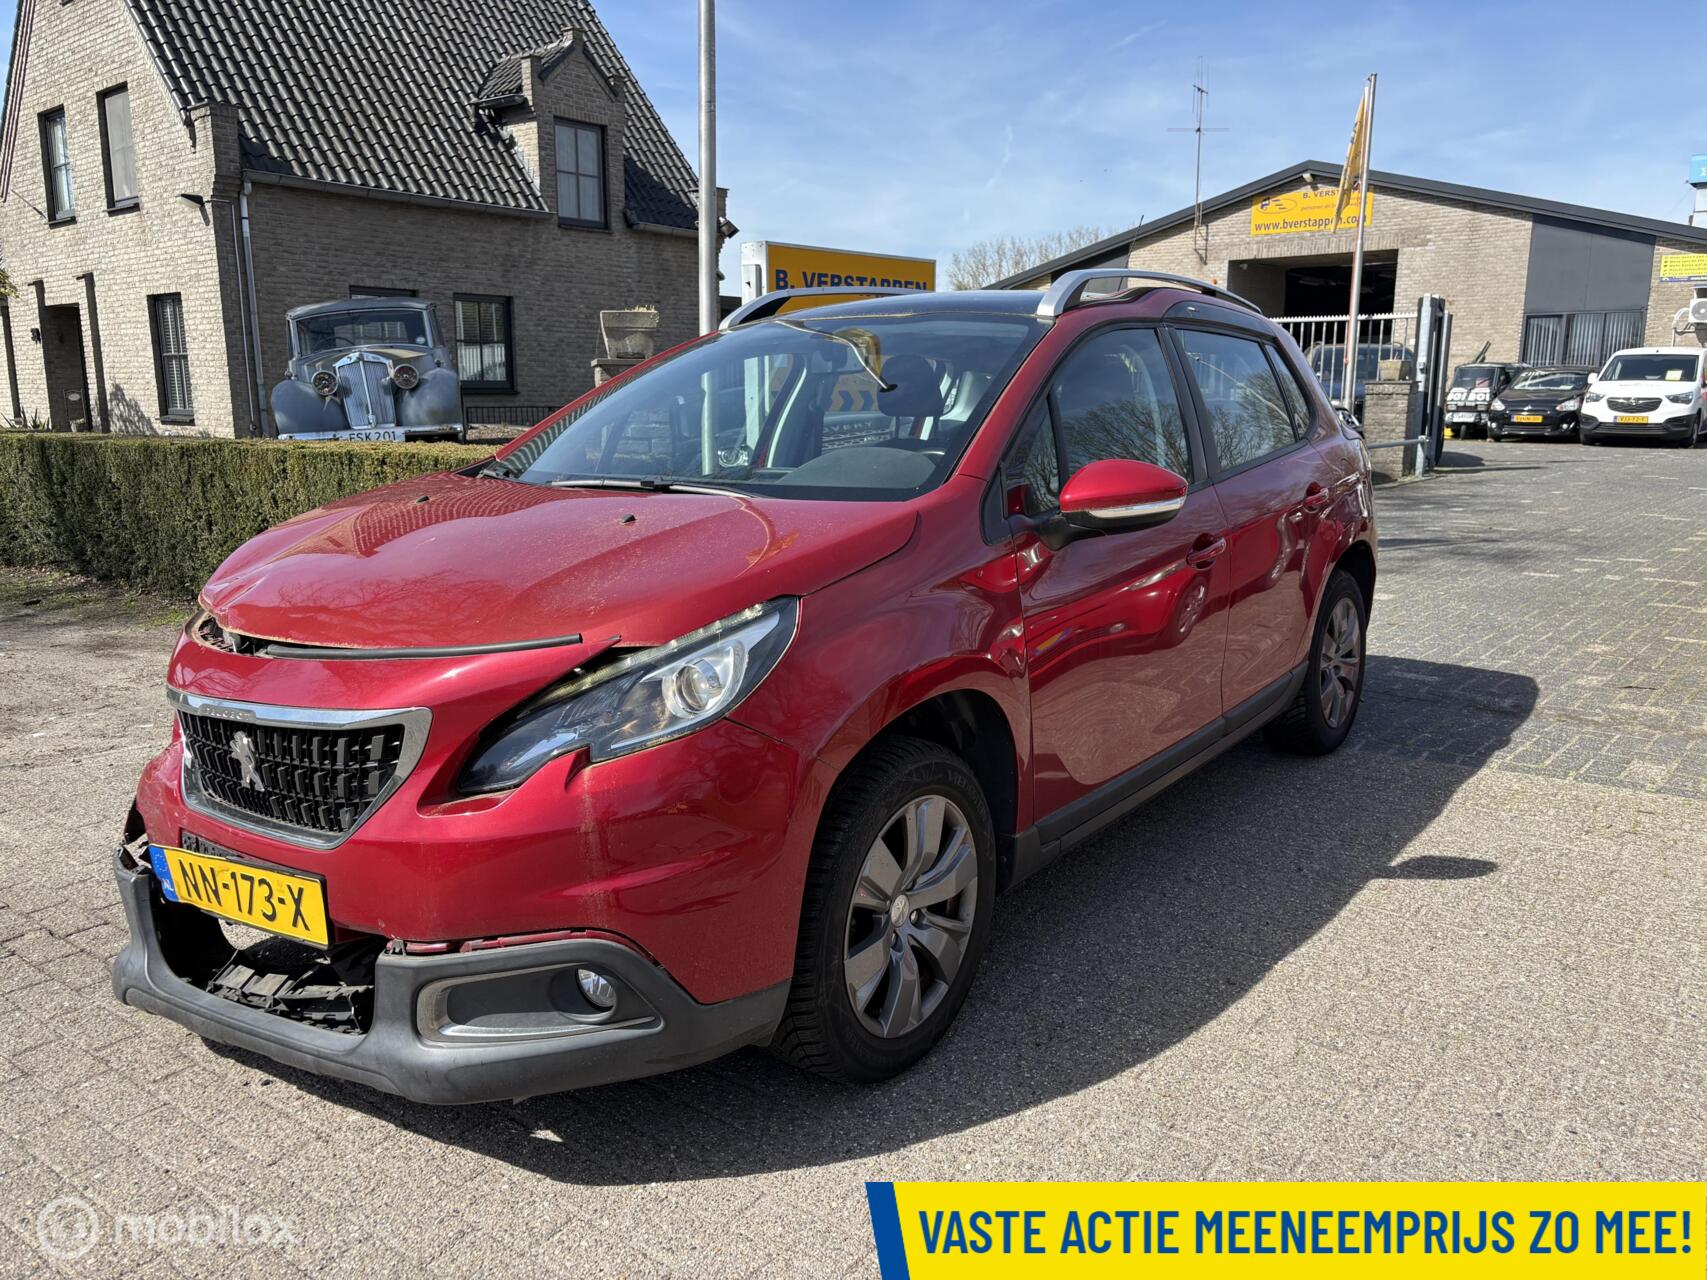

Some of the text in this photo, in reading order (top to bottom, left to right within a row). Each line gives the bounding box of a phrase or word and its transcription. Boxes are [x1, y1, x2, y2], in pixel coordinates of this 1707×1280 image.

[1254, 215, 1367, 231] www.bverstappn.co
[775, 269, 795, 290] B.
[178, 858, 310, 931] NN-173-X
